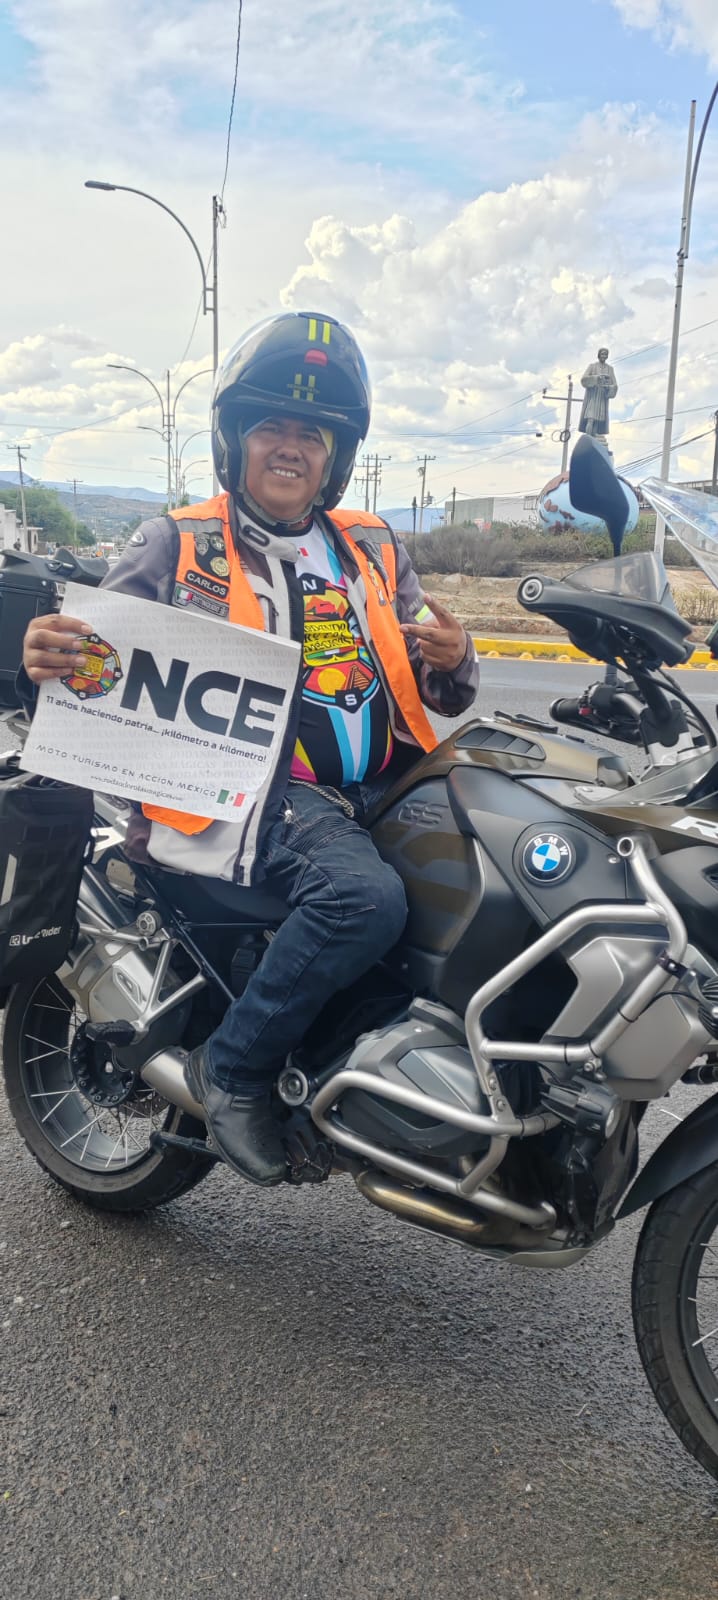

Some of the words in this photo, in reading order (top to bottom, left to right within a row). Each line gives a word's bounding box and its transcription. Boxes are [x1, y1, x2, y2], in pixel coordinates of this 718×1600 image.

[186, 573, 227, 596] CARLOS
[302, 579, 317, 591] N
[344, 693, 358, 706] S
[46, 695, 54, 704] 11
[55, 699, 78, 711] años
[80, 705, 123, 723] haciendo
[219, 743, 267, 763] kilómetro!
[36, 744, 68, 759] MOTO
[72, 754, 118, 772] TURISMO
[121, 768, 136, 777] EN
[139, 772, 174, 787] ACCION
[177, 782, 217, 798] MEXICO
[533, 836, 569, 856] BMW
